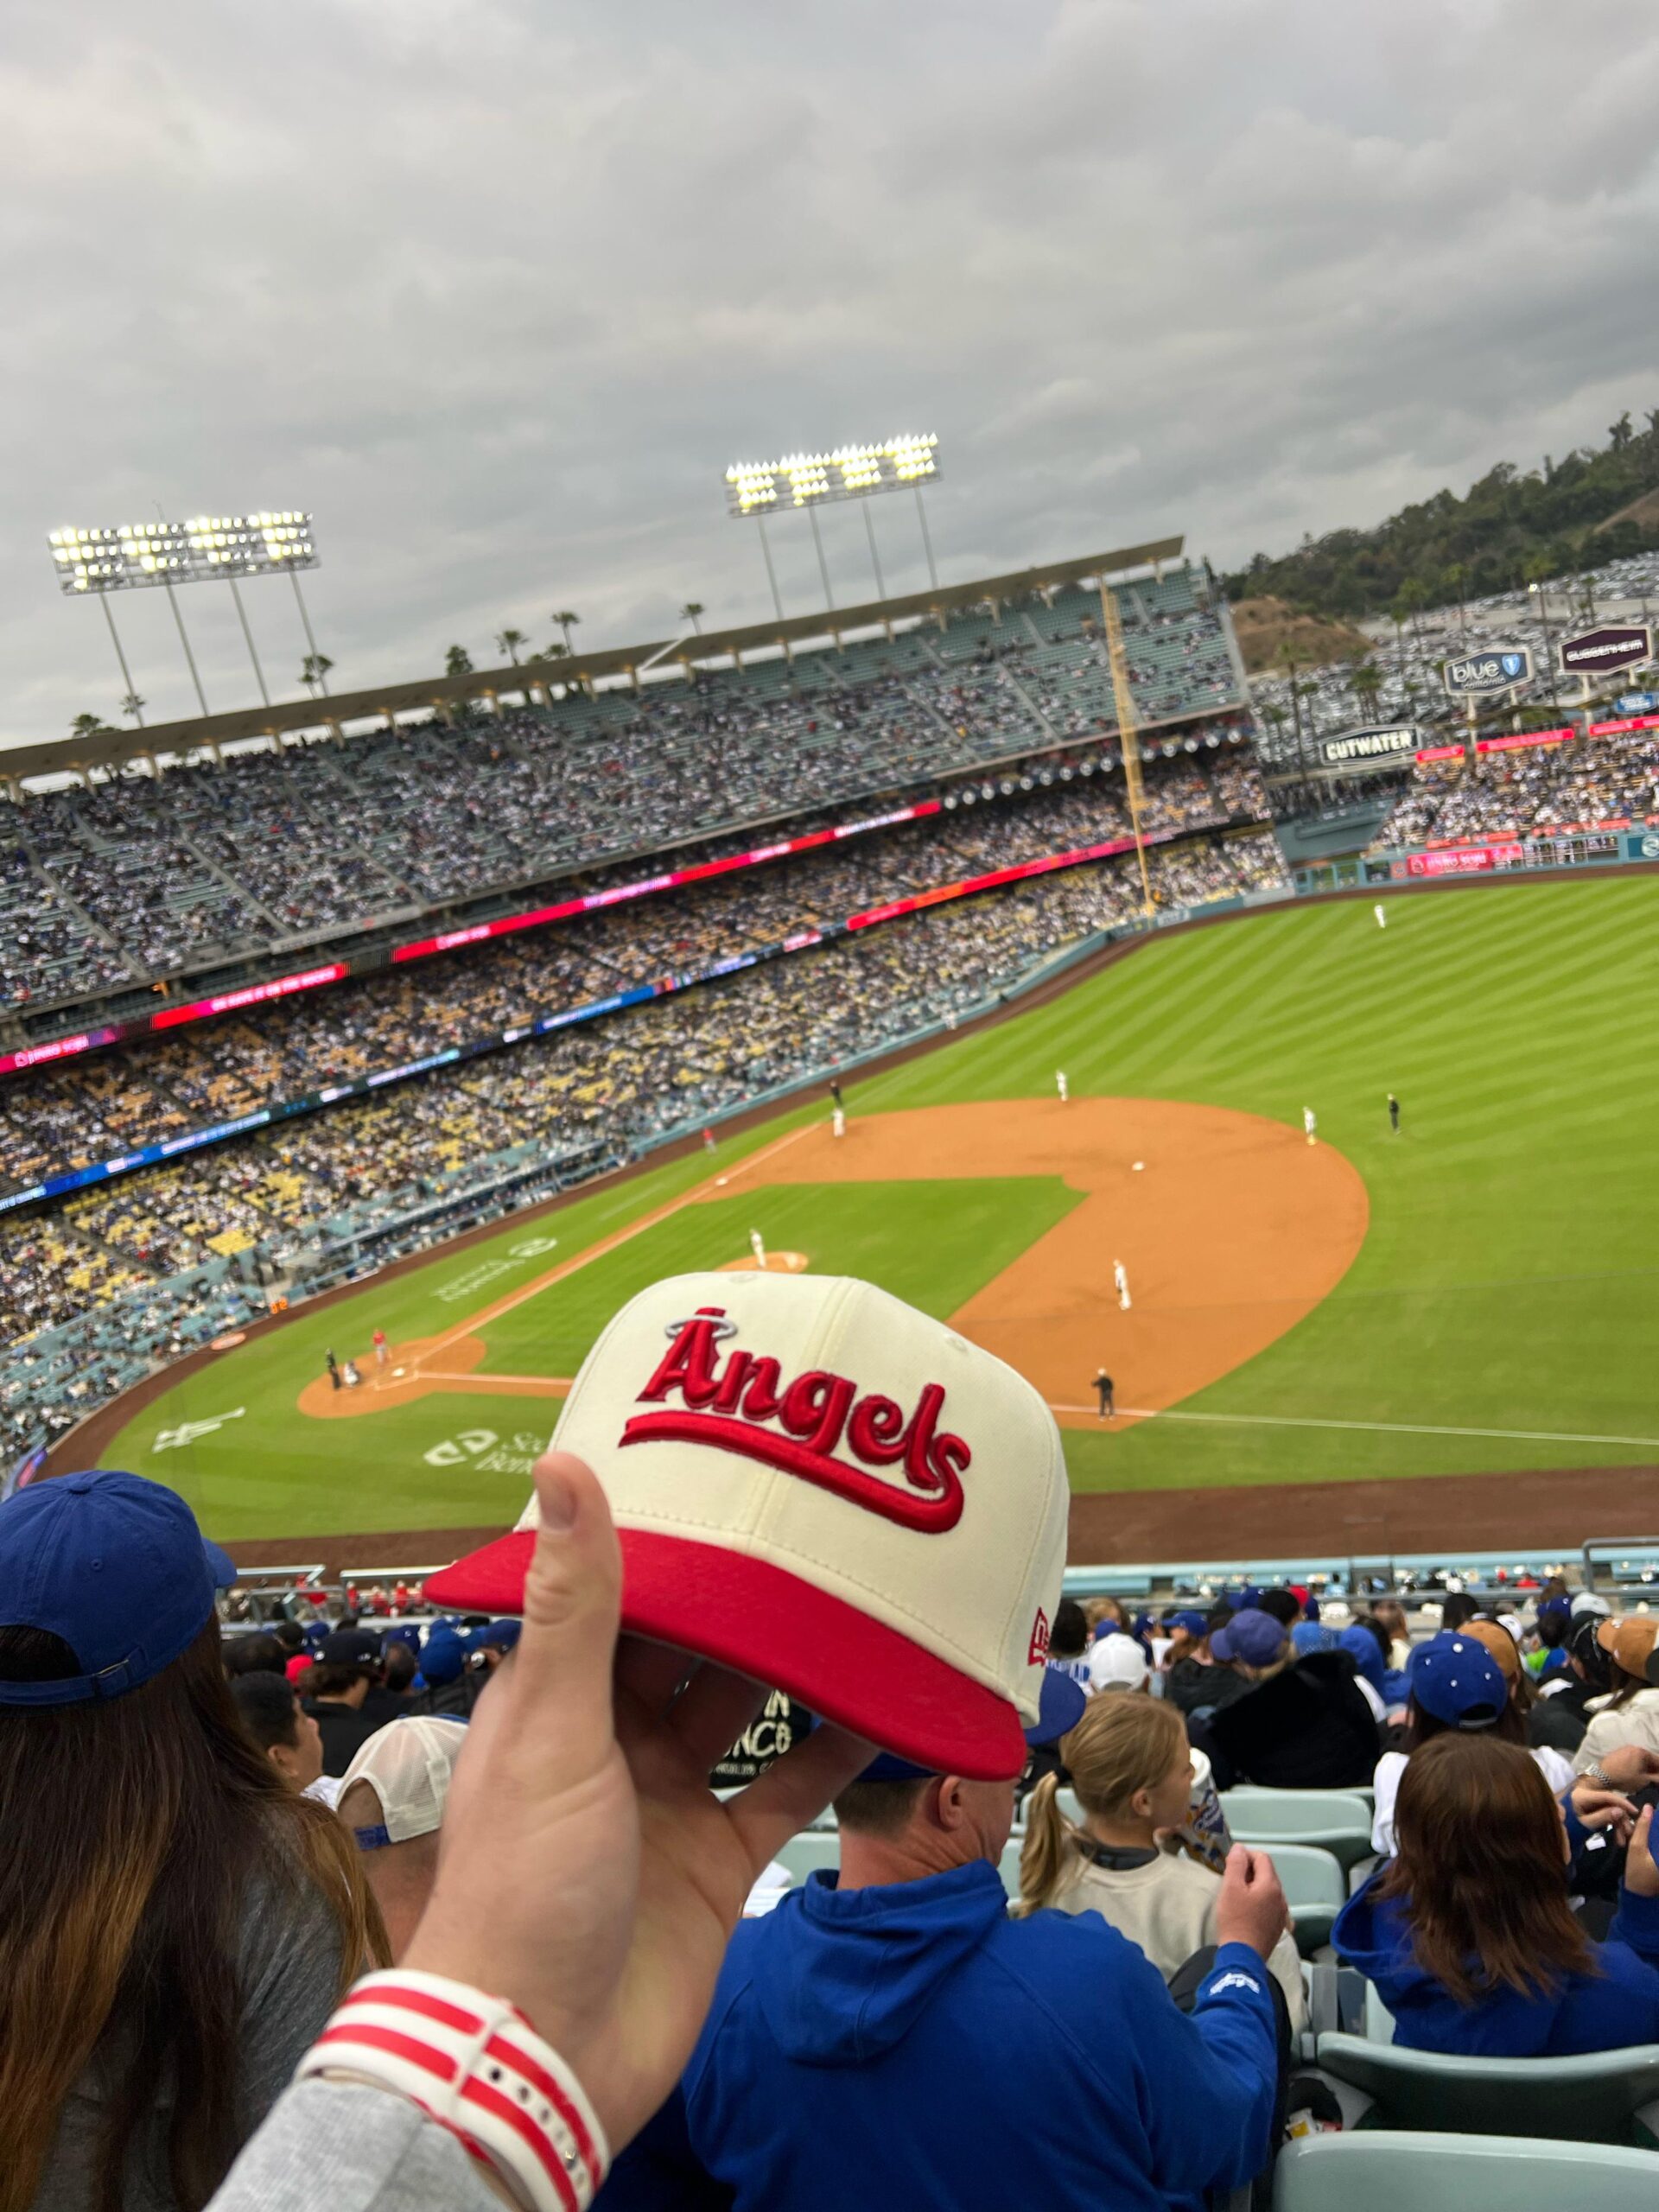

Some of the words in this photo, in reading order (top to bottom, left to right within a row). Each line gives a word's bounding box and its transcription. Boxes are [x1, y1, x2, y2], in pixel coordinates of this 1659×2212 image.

[1567, 639, 1643, 662] GUGGENHEIM
[1452, 660, 1500, 683] blue
[1326, 729, 1412, 760] CUTWATER
[626, 1307, 971, 1522] Angels
